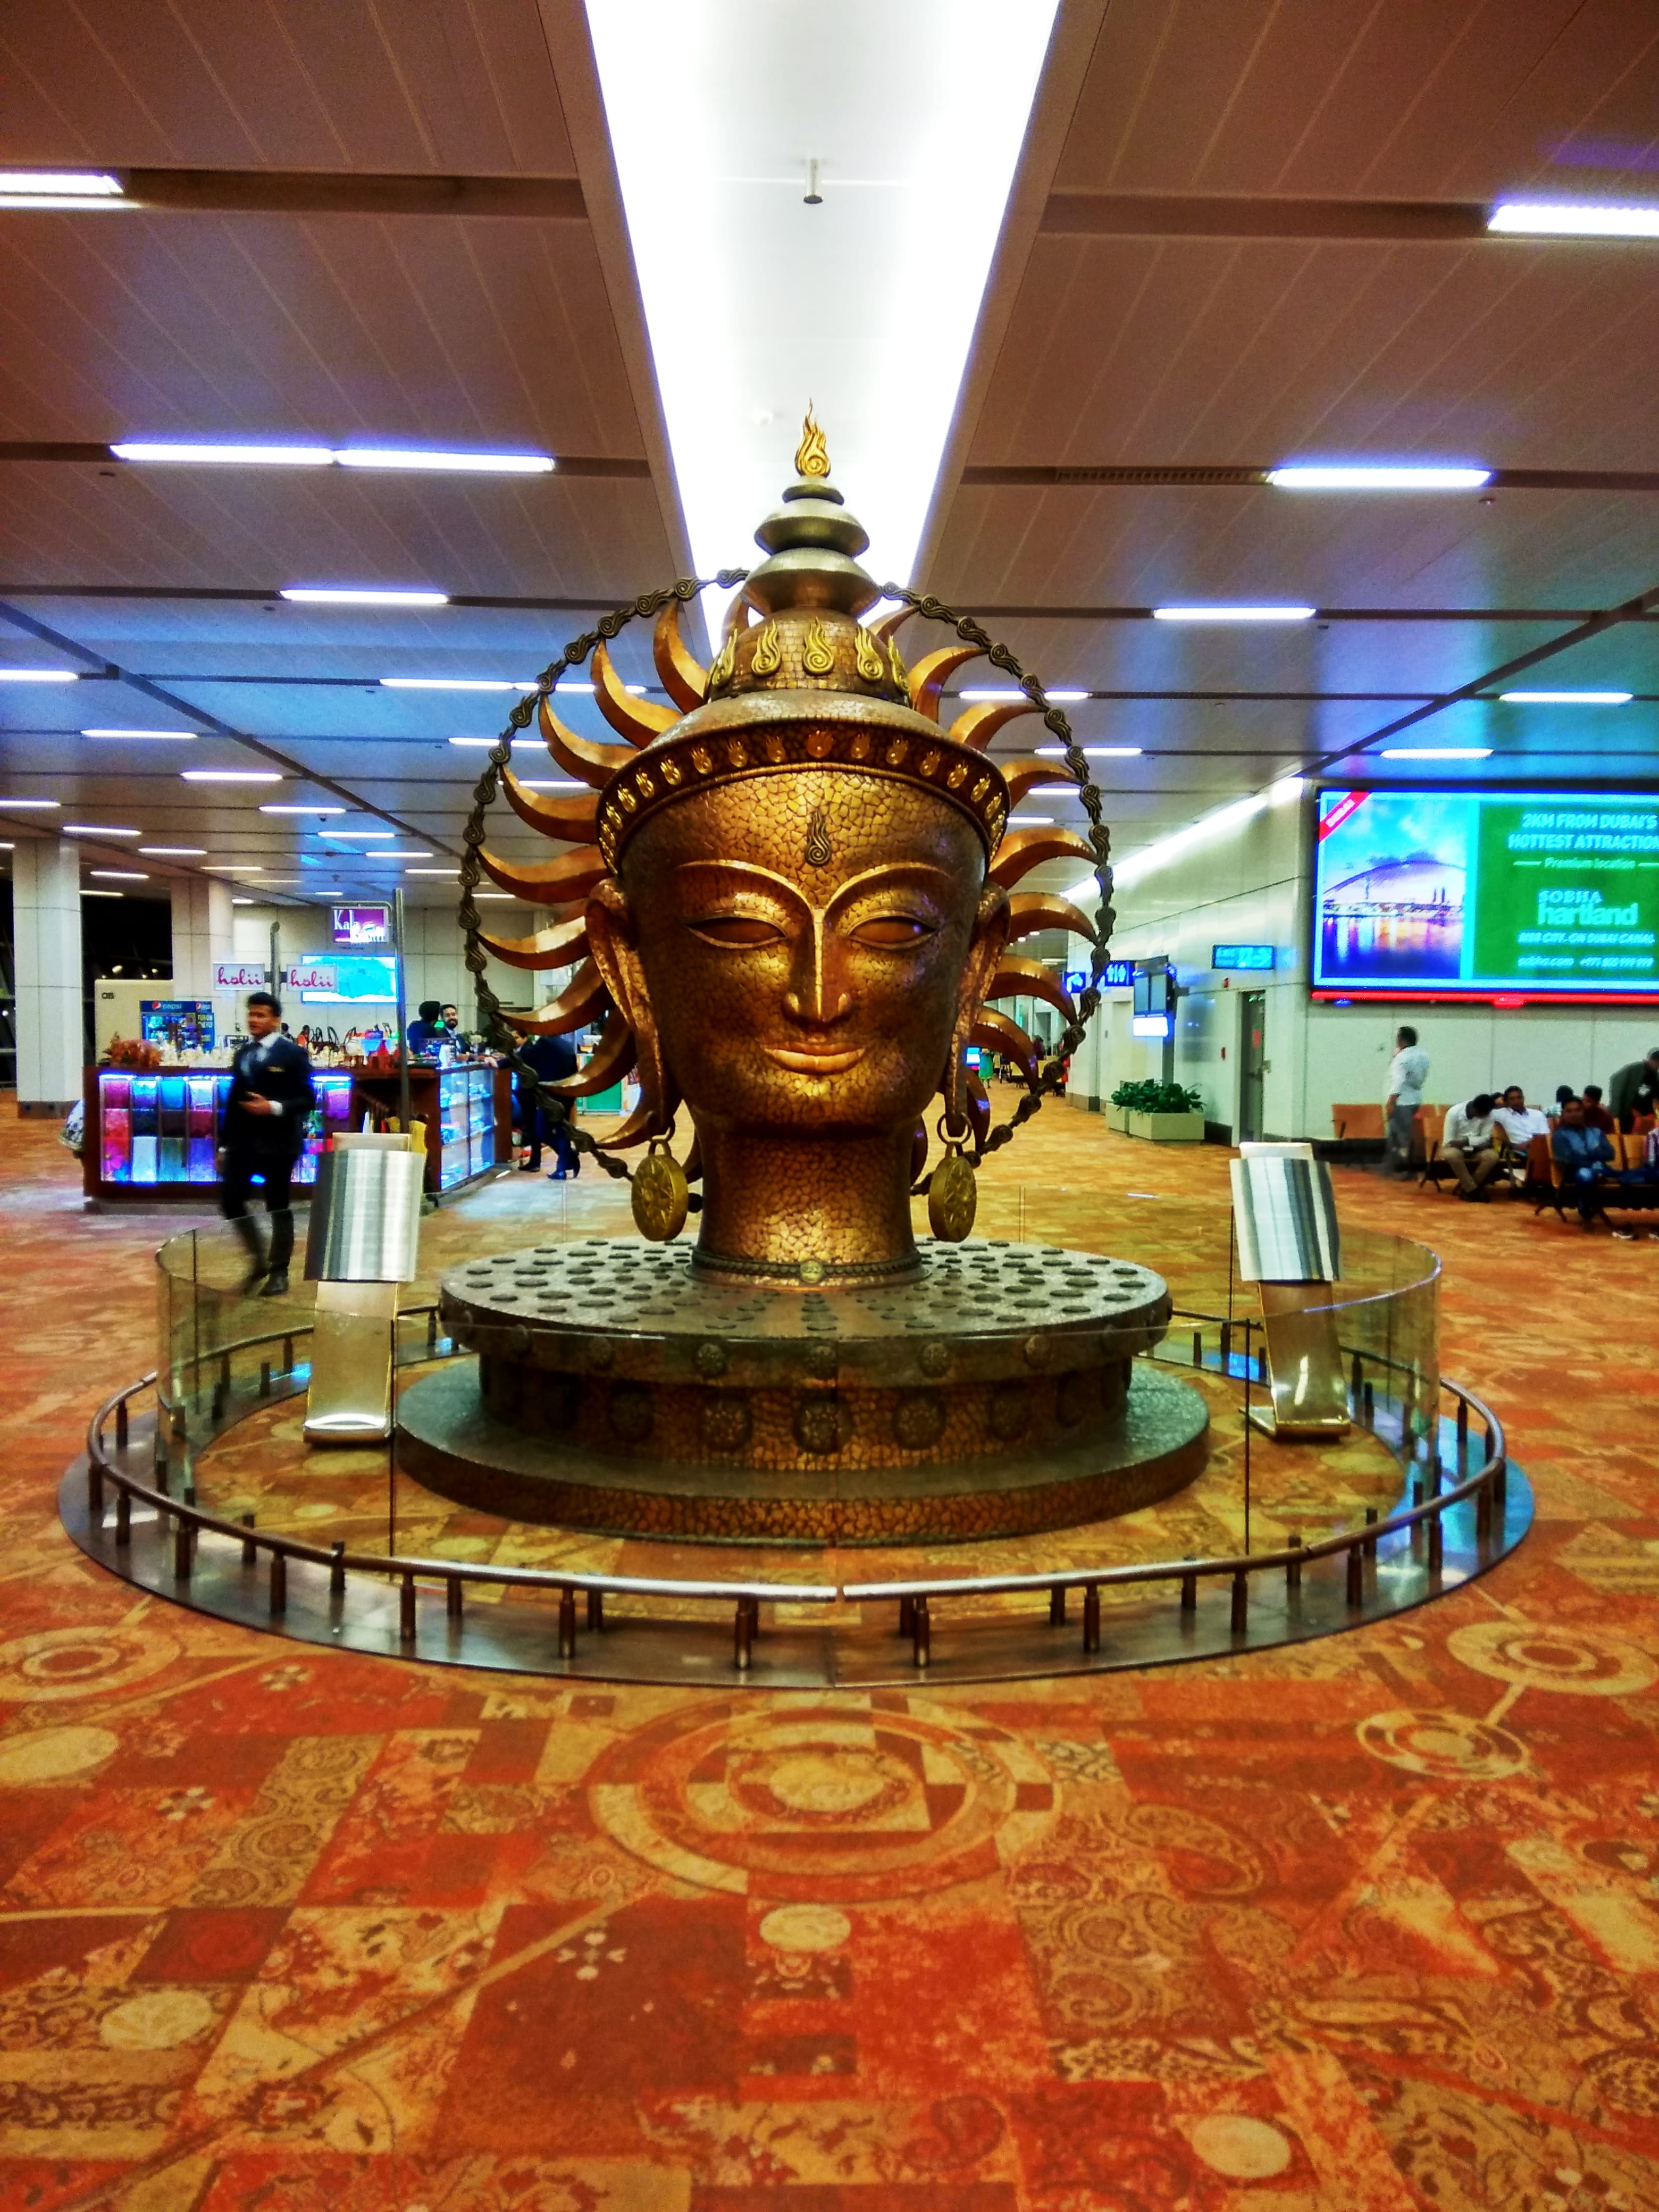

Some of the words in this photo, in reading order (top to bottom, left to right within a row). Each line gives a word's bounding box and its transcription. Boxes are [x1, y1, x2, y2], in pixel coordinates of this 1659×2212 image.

[1522, 814, 1555, 827] 2KM
[1556, 814, 1598, 828] FROM
[1599, 814, 1658, 829] DUBAI'S
[1508, 833, 1574, 849] HOTTEST
[1538, 890, 1603, 903] SOBHA
[1537, 902, 1638, 925] hartland
[217, 966, 262, 985] holii
[290, 969, 333, 987] holii
